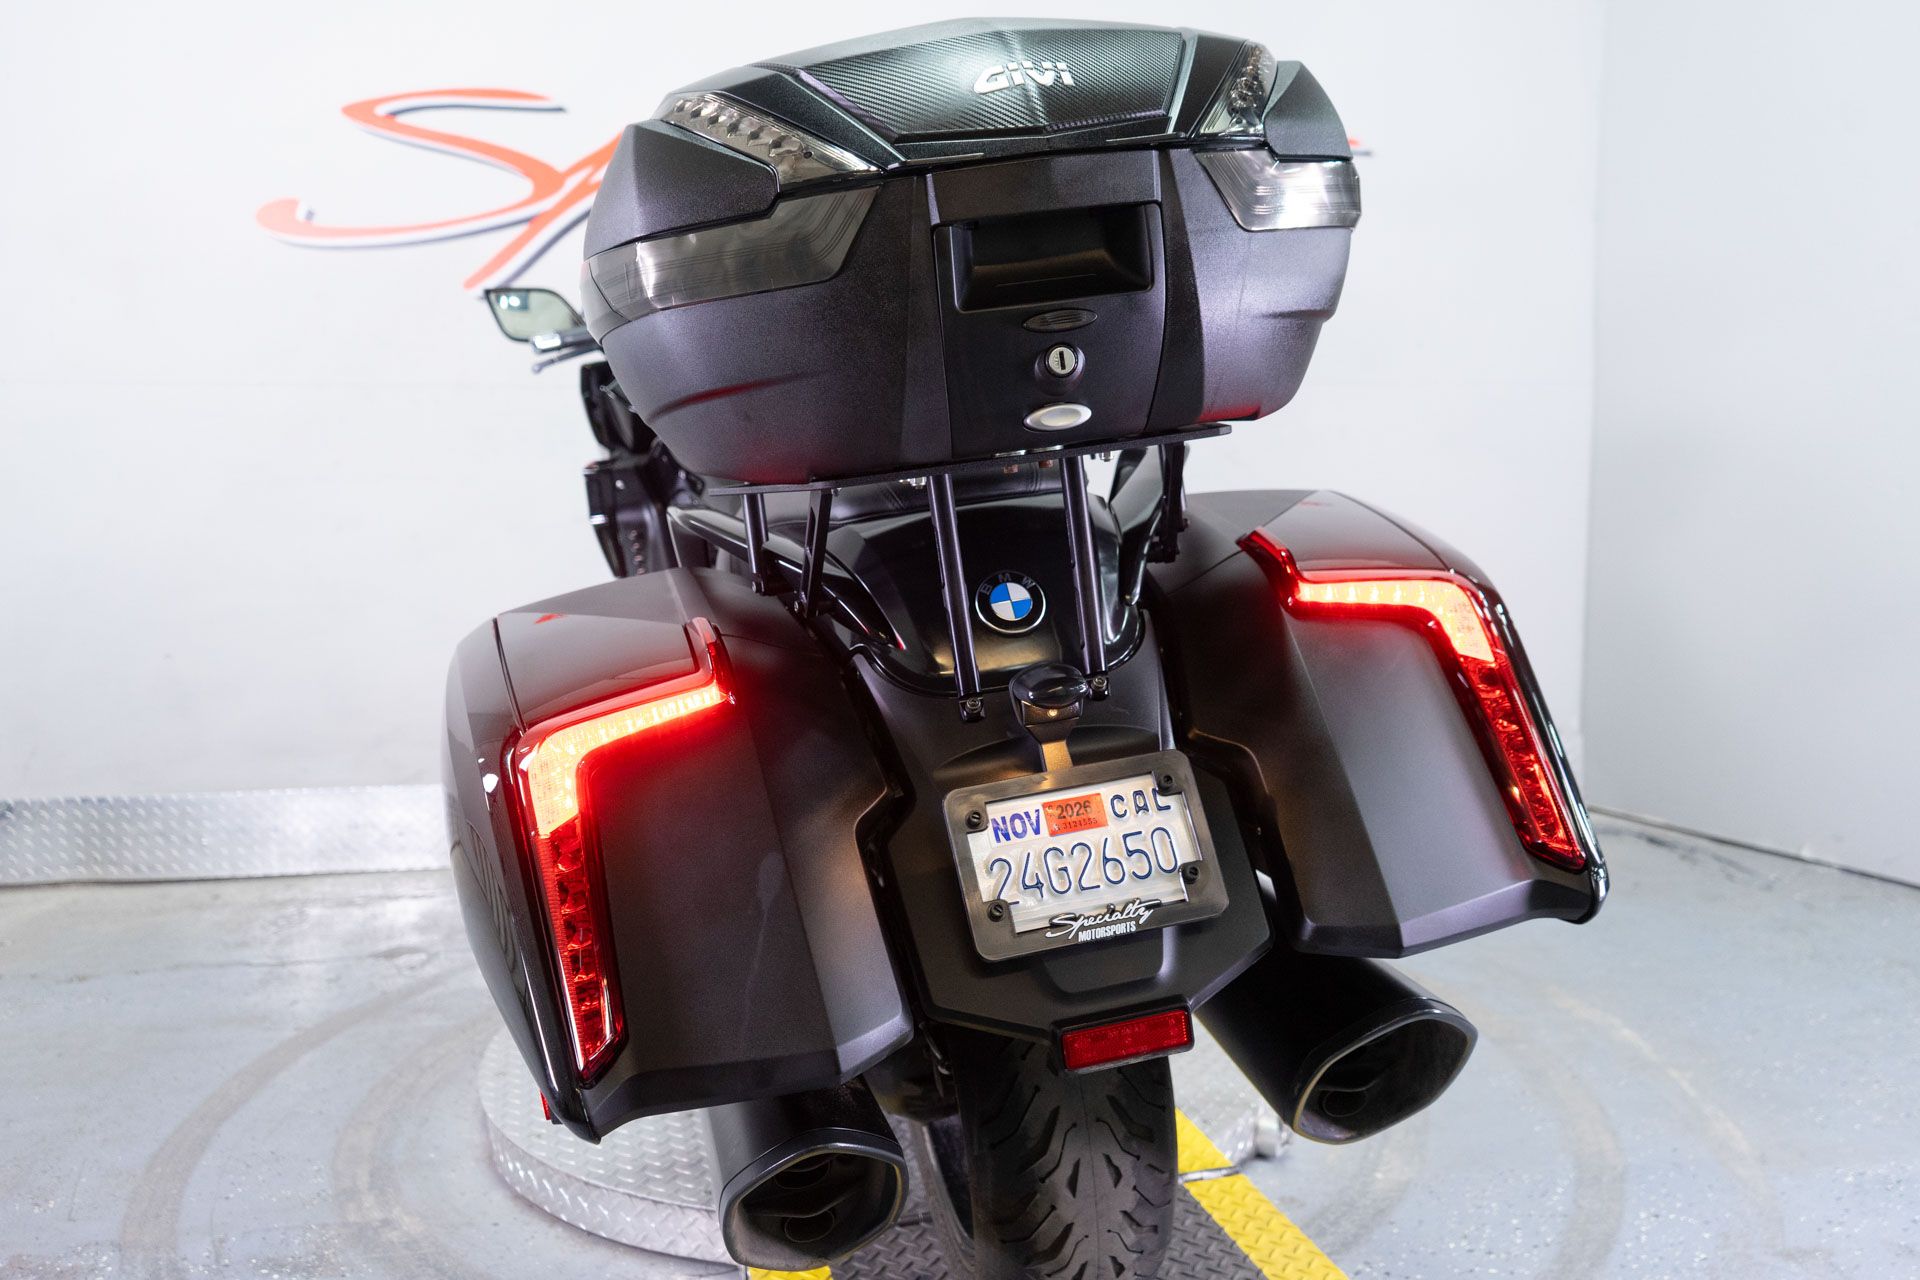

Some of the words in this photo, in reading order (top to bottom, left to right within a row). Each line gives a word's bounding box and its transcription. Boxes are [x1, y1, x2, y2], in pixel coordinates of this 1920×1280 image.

[980, 572, 1036, 596] BMW
[1056, 800, 1092, 819] 2026
[1110, 787, 1171, 818] CAL
[991, 808, 1040, 843] NOV
[989, 826, 1178, 905] 24G2650
[1045, 898, 1161, 939] Specialty
[1078, 920, 1137, 942] MOTORSPORTS
